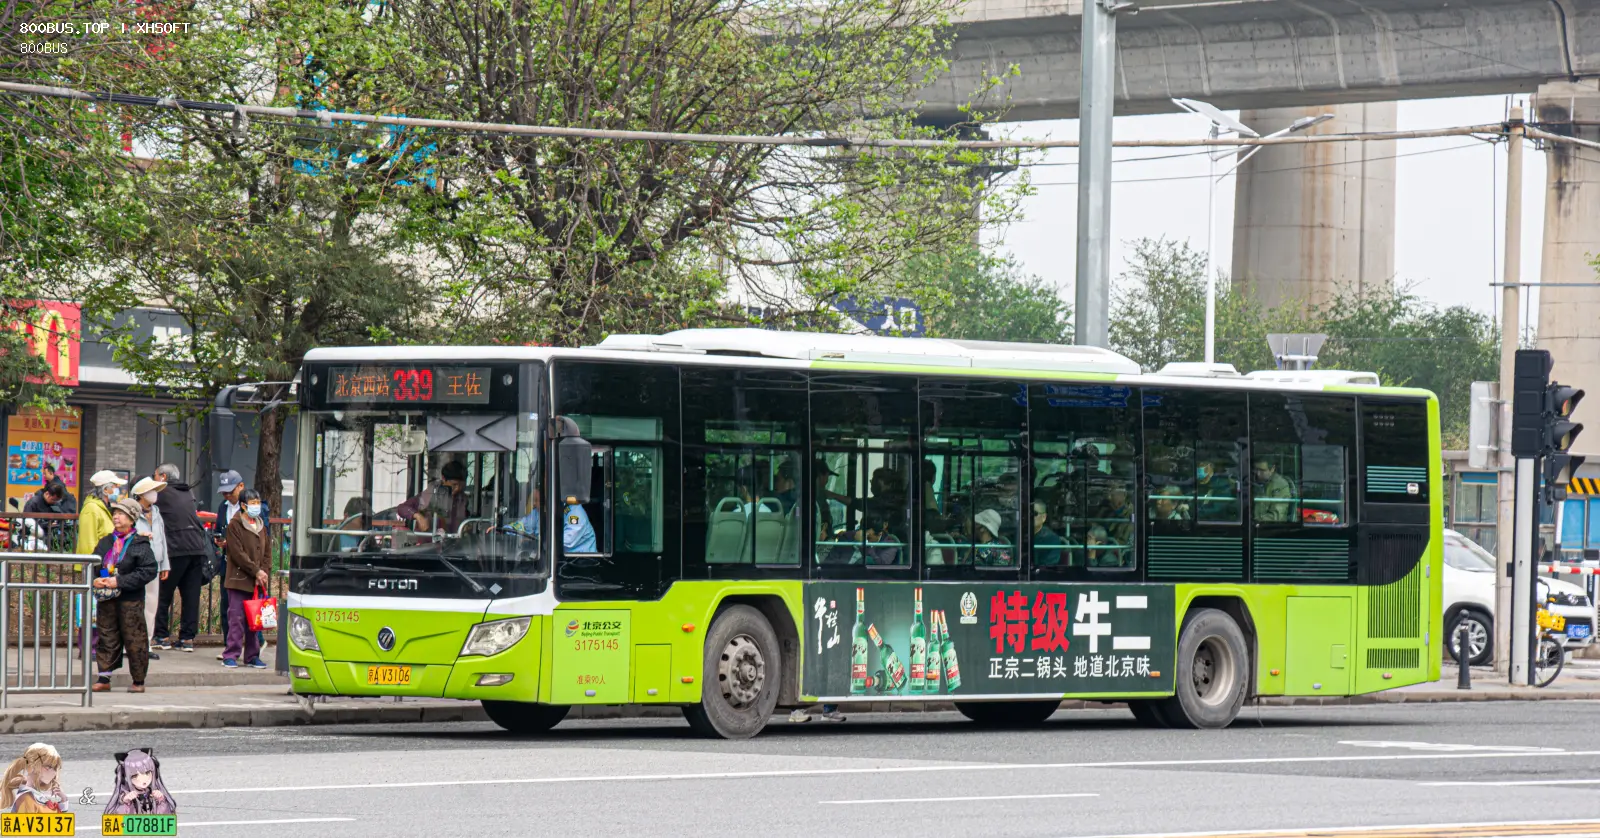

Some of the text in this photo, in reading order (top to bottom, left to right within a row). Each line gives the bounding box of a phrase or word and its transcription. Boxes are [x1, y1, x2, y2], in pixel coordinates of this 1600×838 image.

[335, 369, 483, 401] 北京西站 339 王佐
[368, 578, 418, 590] FOTON
[315, 610, 360, 623] 3175145
[990, 590, 1151, 654] 特级牛二
[582, 621, 622, 630] 北京公交
[574, 639, 619, 651] 3175145
[988, 655, 1150, 679] 正宗二锅头 地道北京味
[577, 674, 606, 685] 准乘90人
